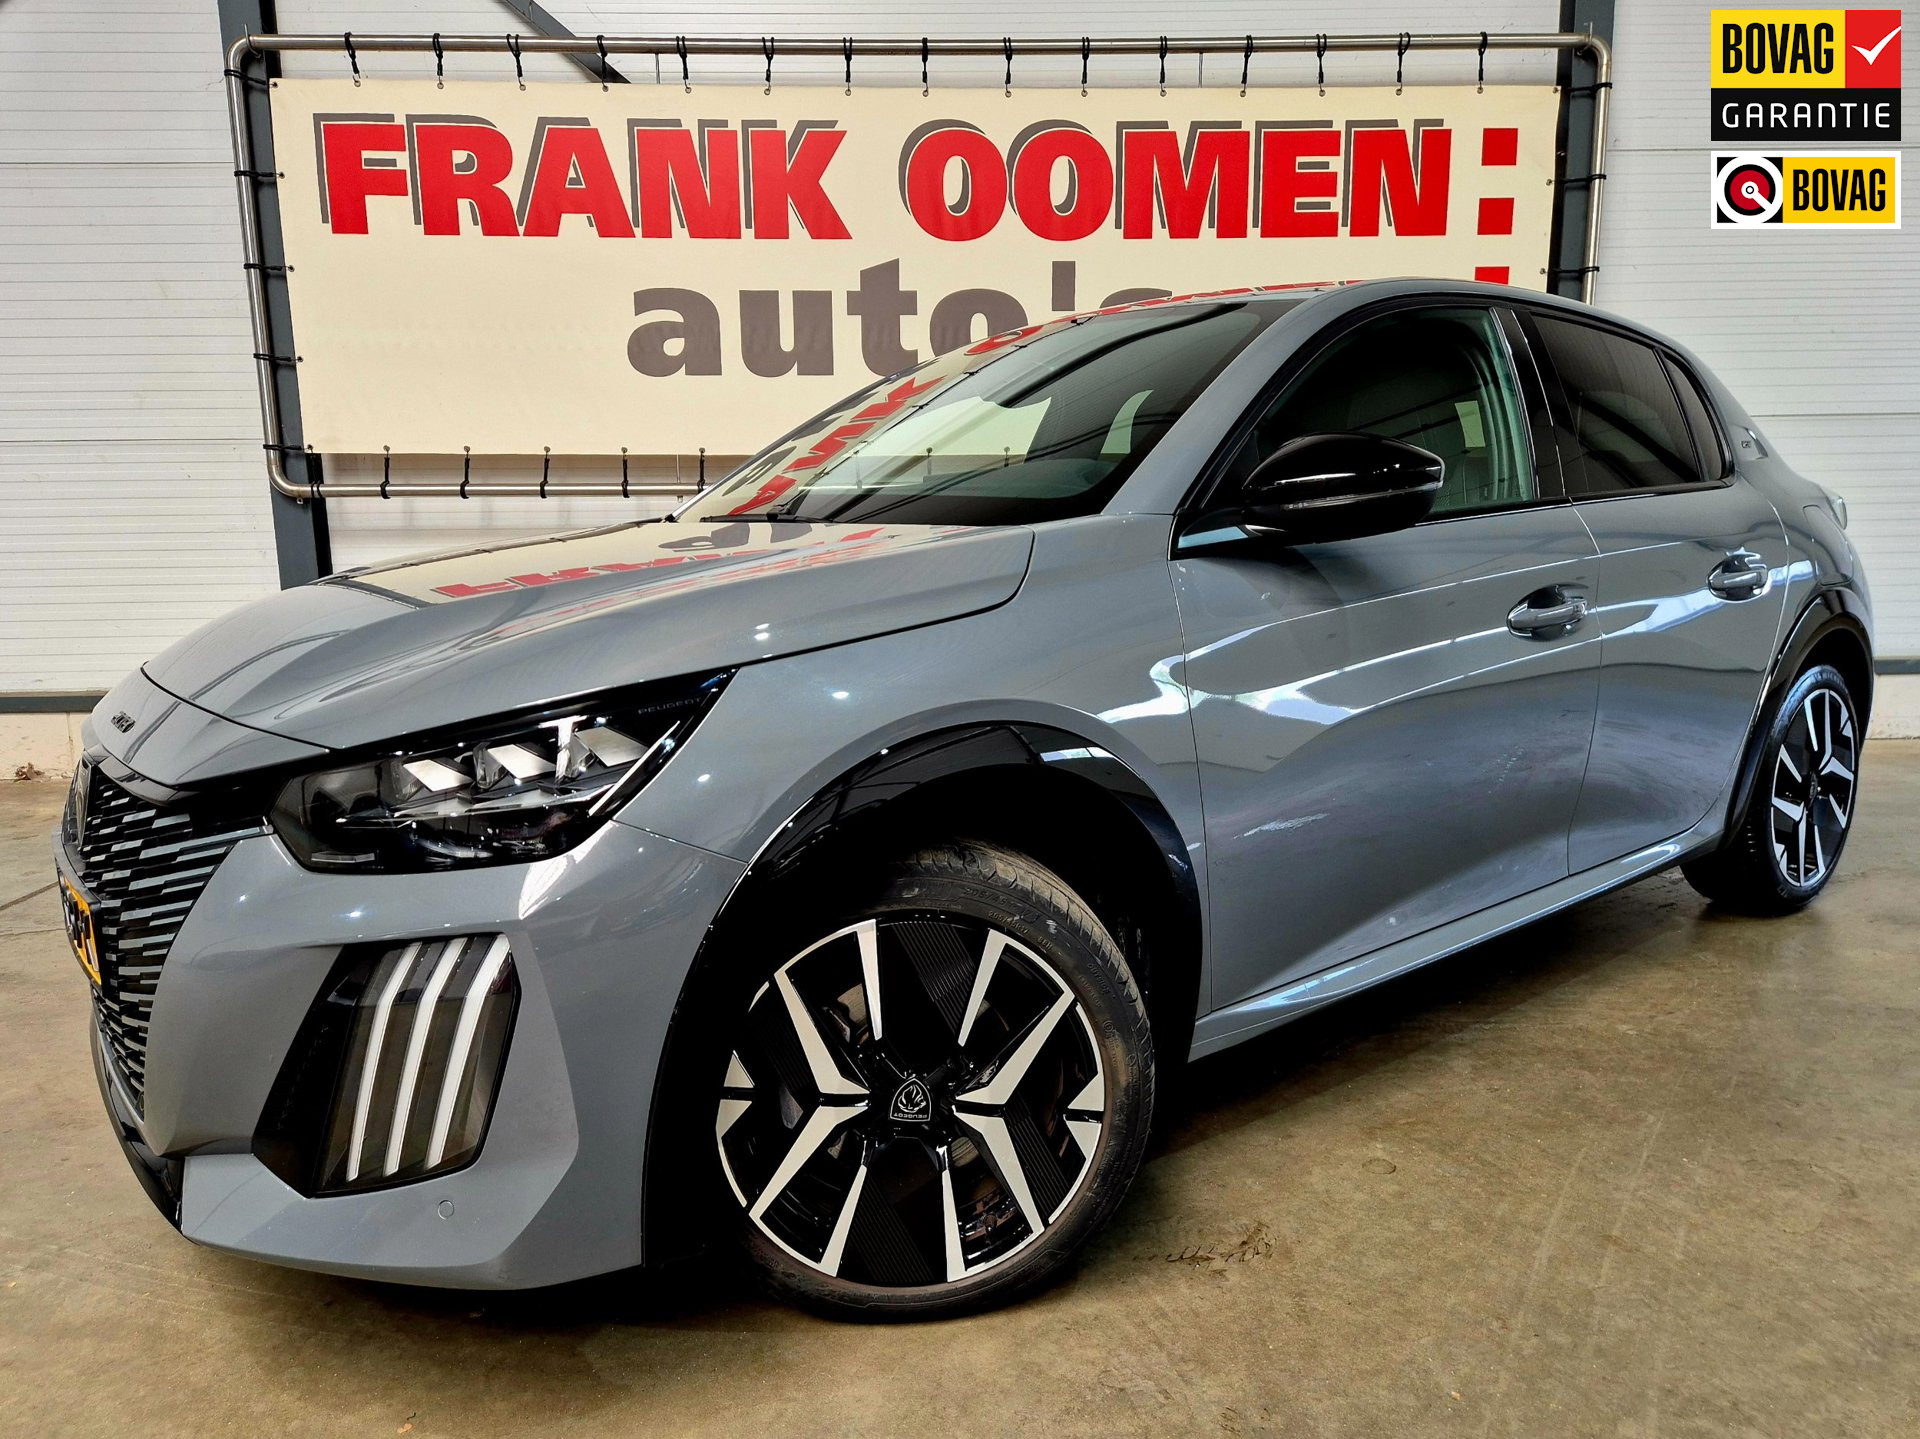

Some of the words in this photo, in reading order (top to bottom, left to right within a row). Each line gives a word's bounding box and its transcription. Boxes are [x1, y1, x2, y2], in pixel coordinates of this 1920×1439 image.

[313, 113, 853, 239] FRANK
[899, 119, 1452, 241] OOMEN
[627, 258, 1172, 377] auto'
[638, 697, 701, 714] PEUGEOT
